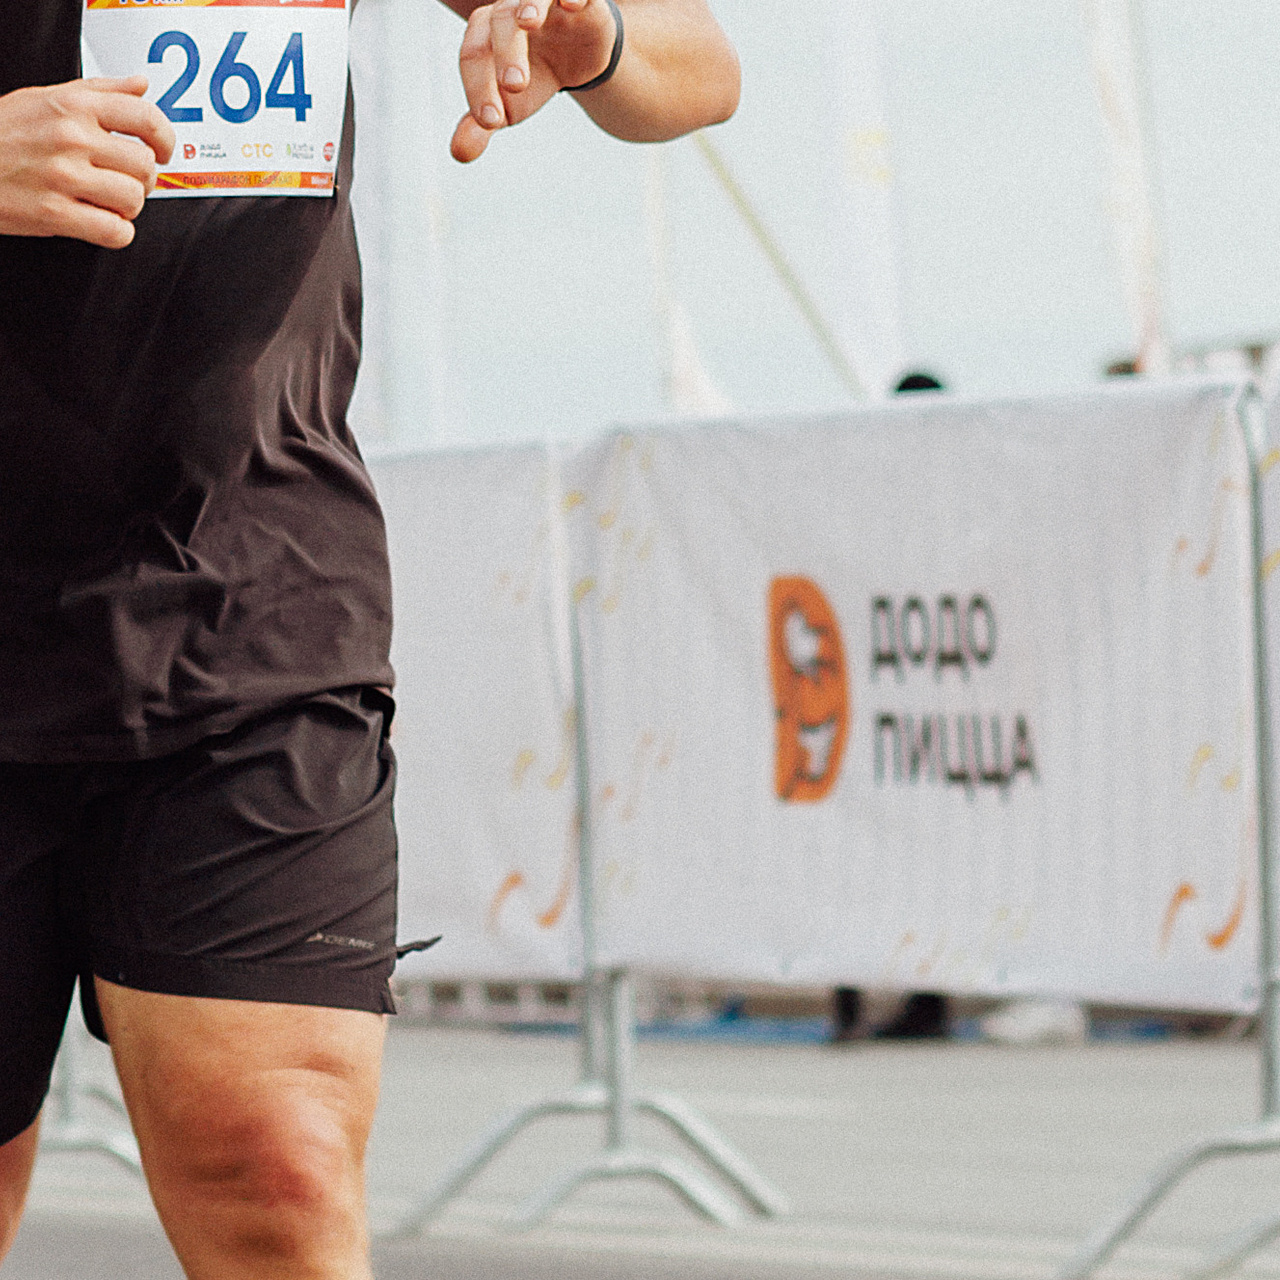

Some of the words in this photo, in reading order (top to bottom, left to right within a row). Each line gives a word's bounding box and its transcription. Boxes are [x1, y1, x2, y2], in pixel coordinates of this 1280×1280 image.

[147, 30, 313, 124] 264
[869, 593, 997, 684] ДОДО
[872, 713, 1041, 803] ПИЦЦА
